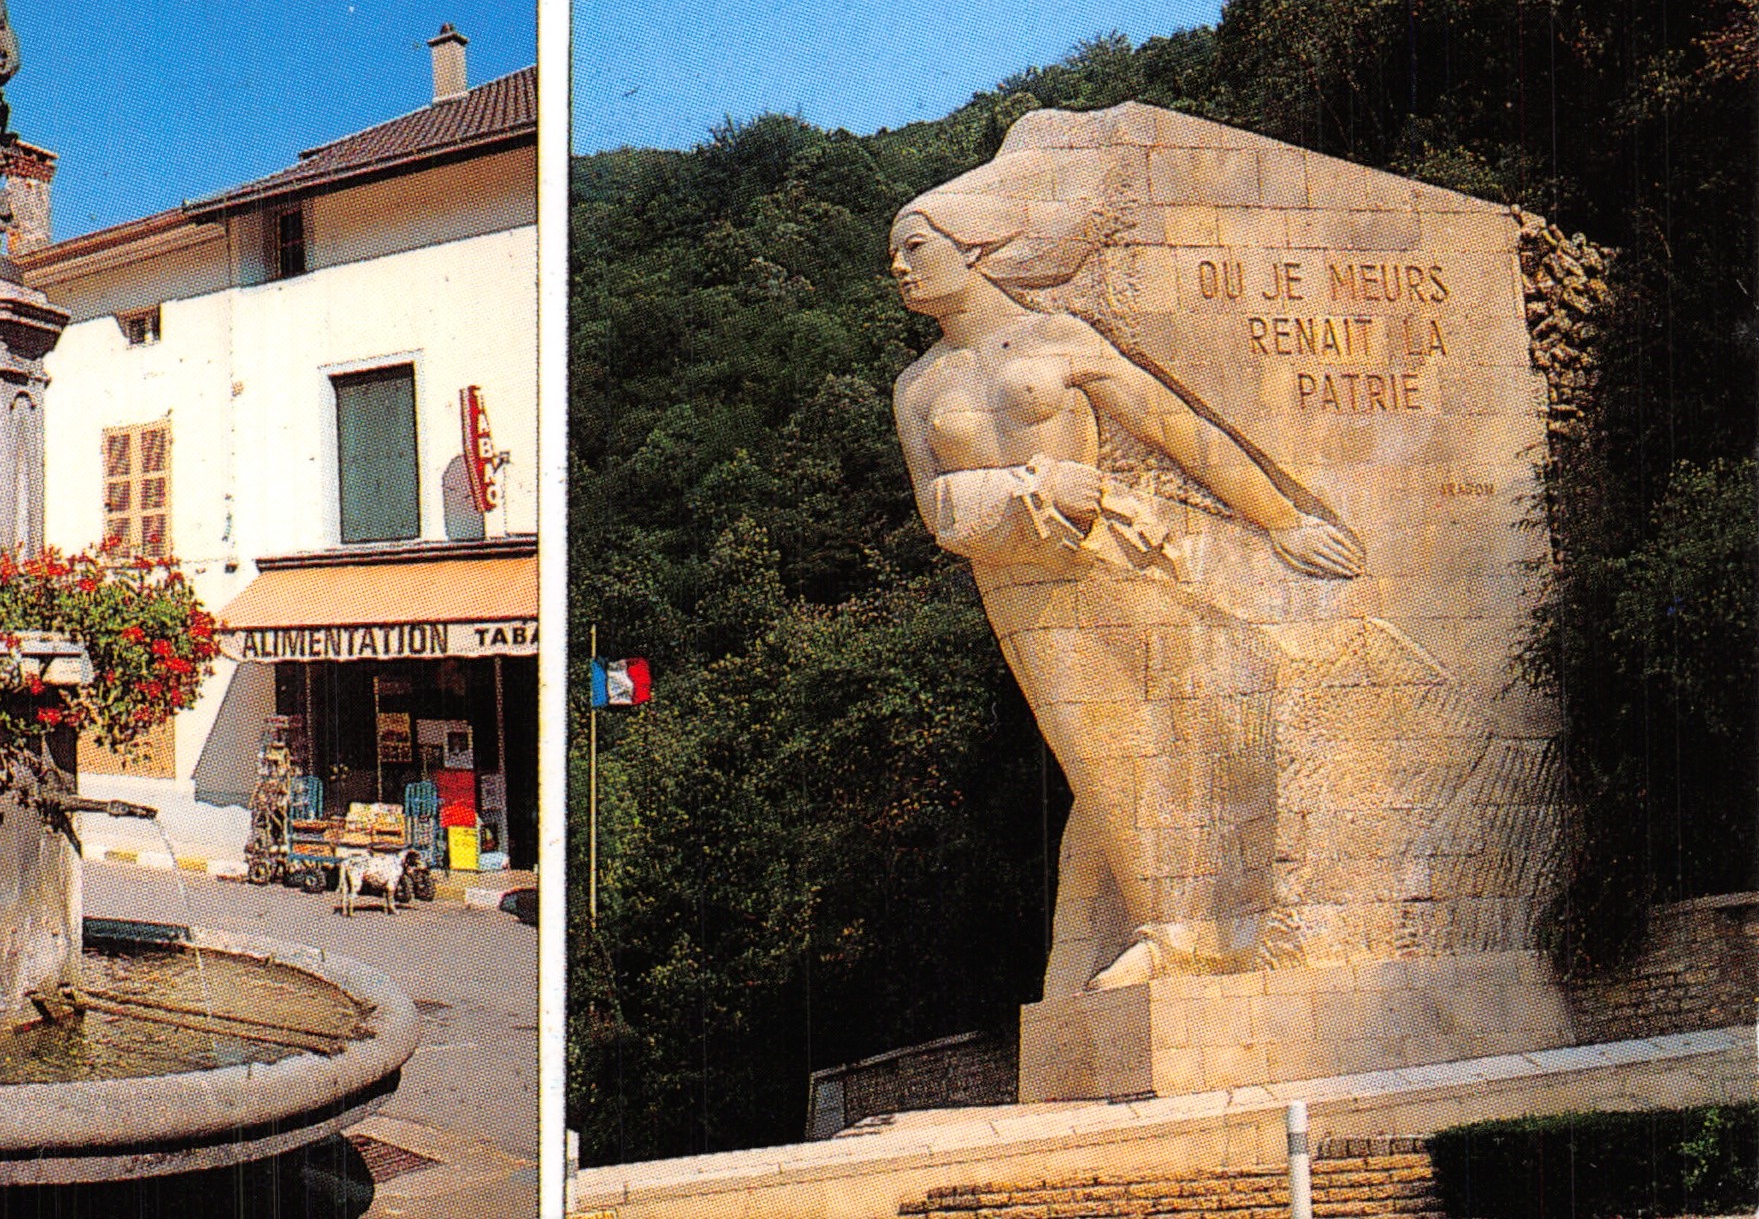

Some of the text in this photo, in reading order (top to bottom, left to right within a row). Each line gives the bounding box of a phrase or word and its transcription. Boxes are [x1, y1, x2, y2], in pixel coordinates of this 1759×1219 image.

[1262, 262, 1303, 300] JE
[1328, 264, 1450, 303] MEURS
[1402, 318, 1448, 357] LA
[1298, 372, 1422, 411] PATRIE
[242, 625, 448, 659] ALIMENTATION
